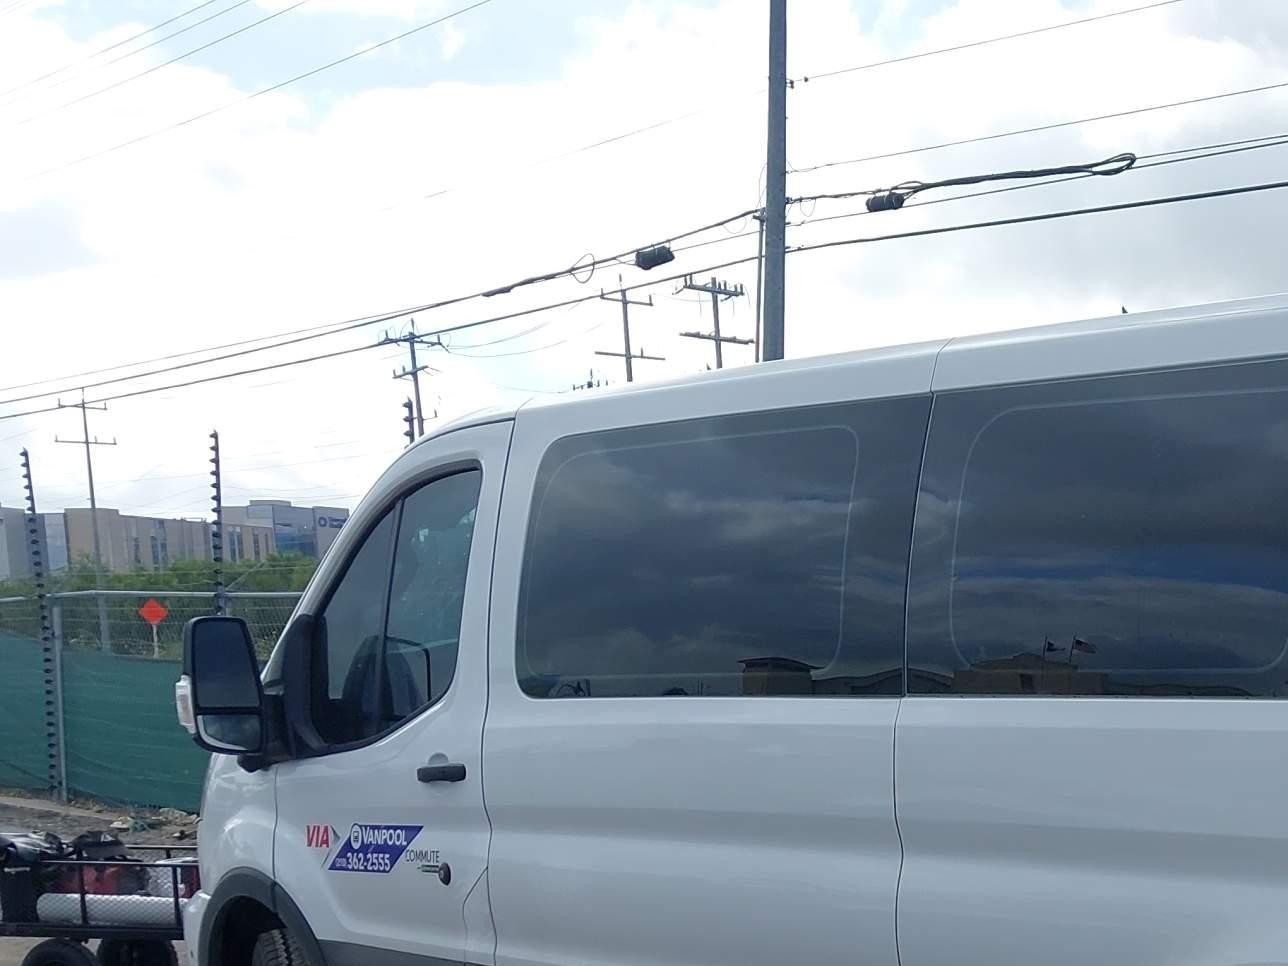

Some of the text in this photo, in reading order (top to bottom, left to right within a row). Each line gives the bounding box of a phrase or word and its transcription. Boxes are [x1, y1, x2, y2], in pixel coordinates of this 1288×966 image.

[306, 825, 330, 848] VIA
[361, 827, 407, 846] VANPOOL
[347, 852, 391, 871] 362-2555
